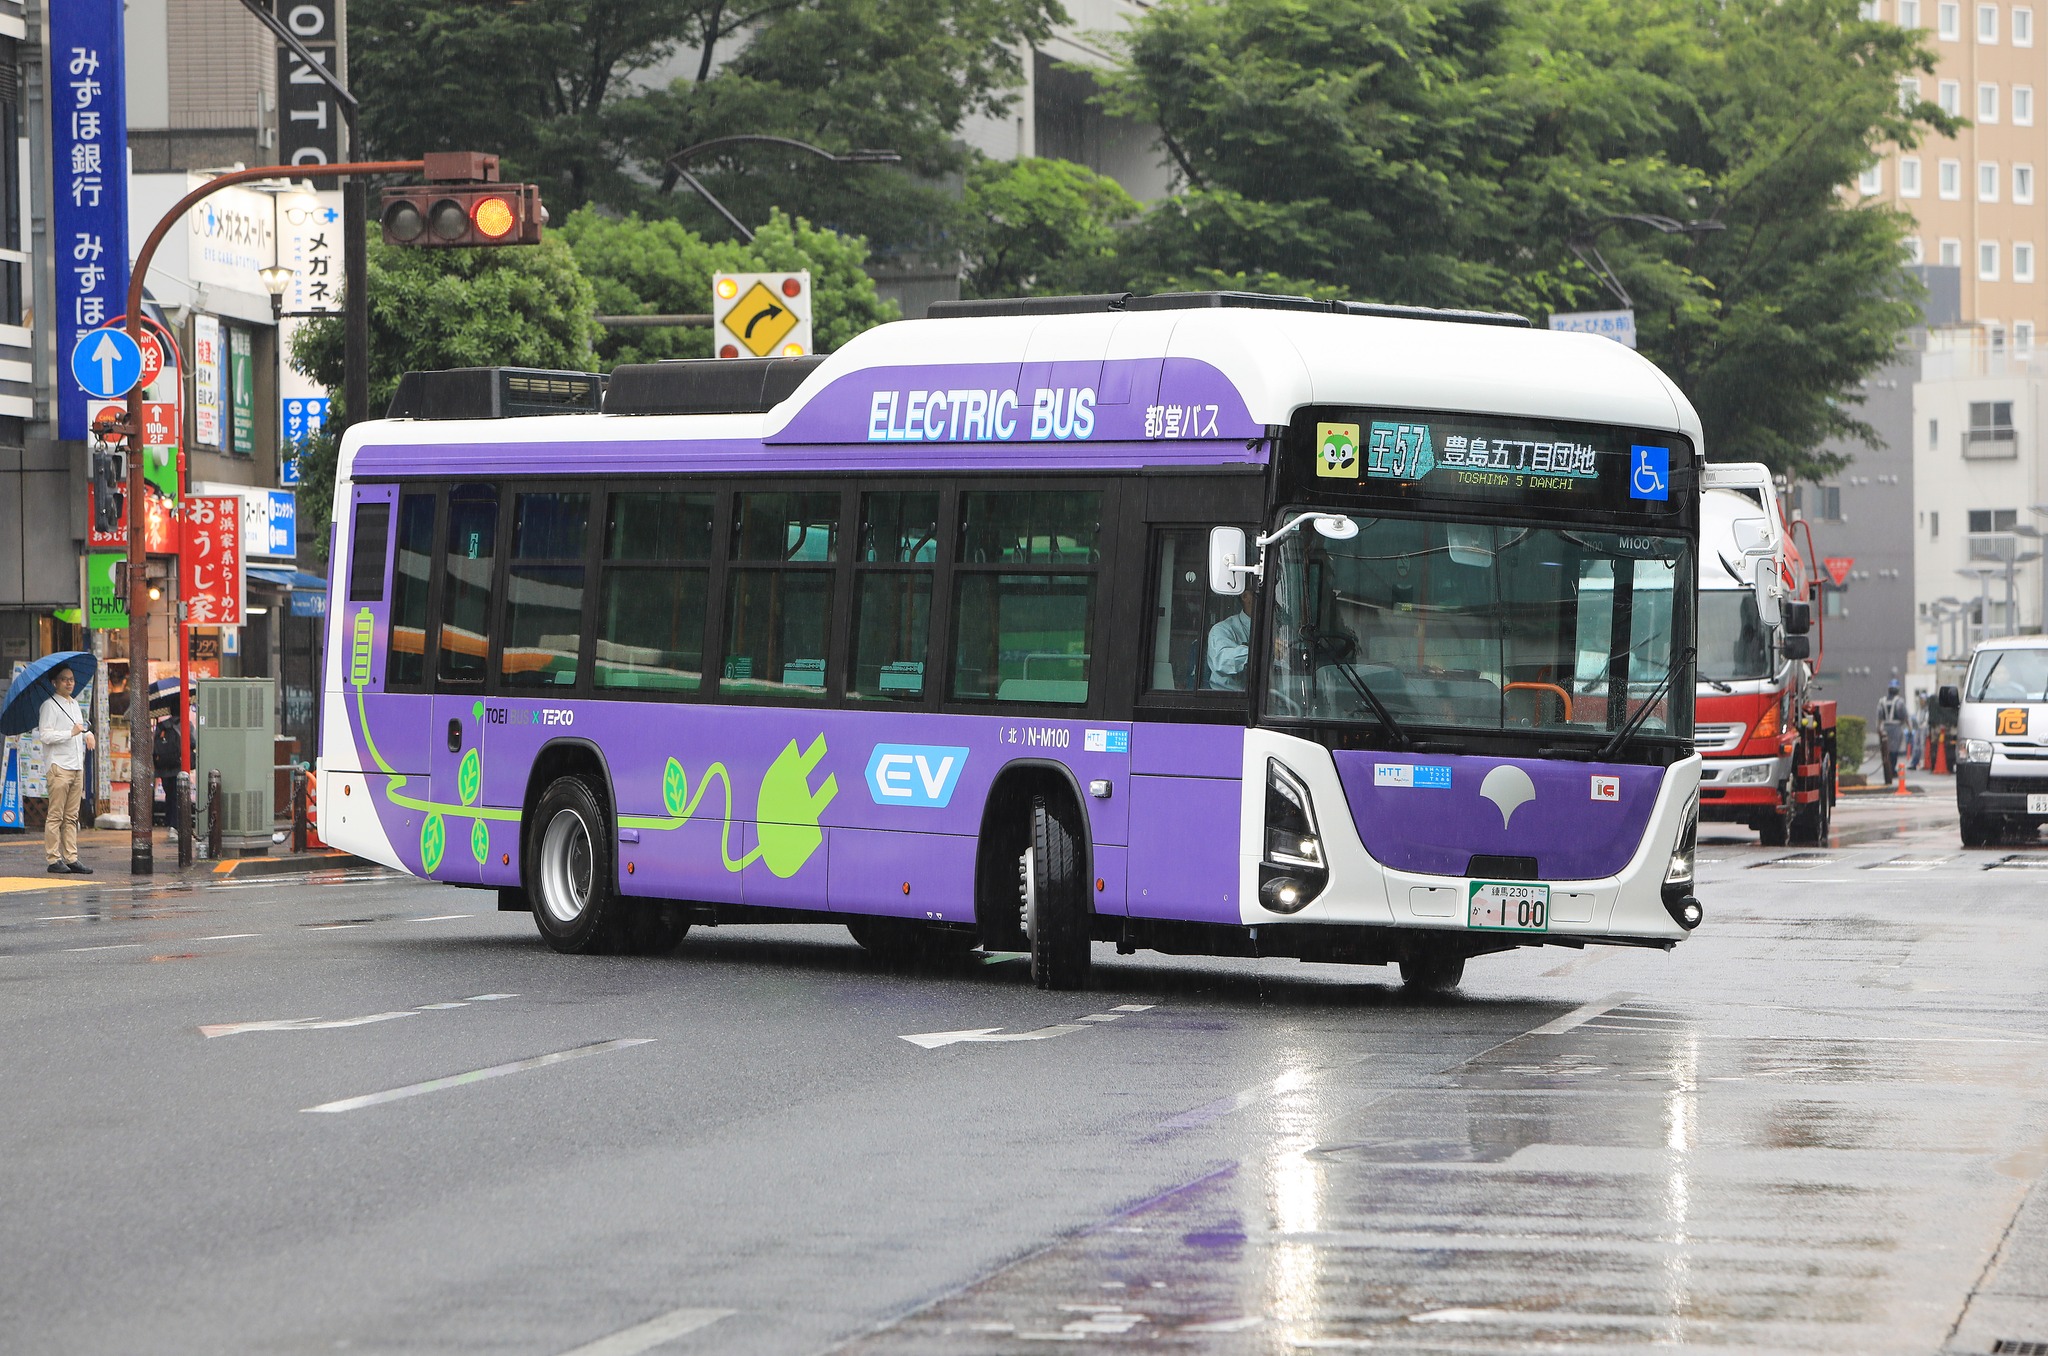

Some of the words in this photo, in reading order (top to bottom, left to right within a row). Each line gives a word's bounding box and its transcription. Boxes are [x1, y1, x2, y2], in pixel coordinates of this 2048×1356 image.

[70, 48, 102, 207] みずほ銀行
[74, 233, 105, 342] みずほ
[309, 233, 331, 311] メガネ
[146, 422, 168, 434] 100m
[868, 388, 1018, 441] ELECTRIC
[1030, 387, 1096, 440] BUS
[1144, 404, 1219, 439] 都営バス
[150, 434, 164, 443] 2F
[1367, 425, 1425, 477] 王57
[1442, 436, 1596, 475] 豊島五丁目団地
[1457, 471, 1509, 486] TOSHIMA
[1515, 475, 1524, 487] 5
[1529, 476, 1574, 490] DANCHI
[189, 499, 217, 621] おうじ家
[219, 500, 235, 622] 横浜家系らーめん
[1619, 536, 1650, 550] M100
[486, 708, 508, 724] TOEI
[510, 709, 529, 725] BUS
[543, 709, 574, 726] TEPCO
[1997, 707, 2027, 735] 危
[875, 754, 954, 799] EV
[1378, 767, 1402, 777] HTT
